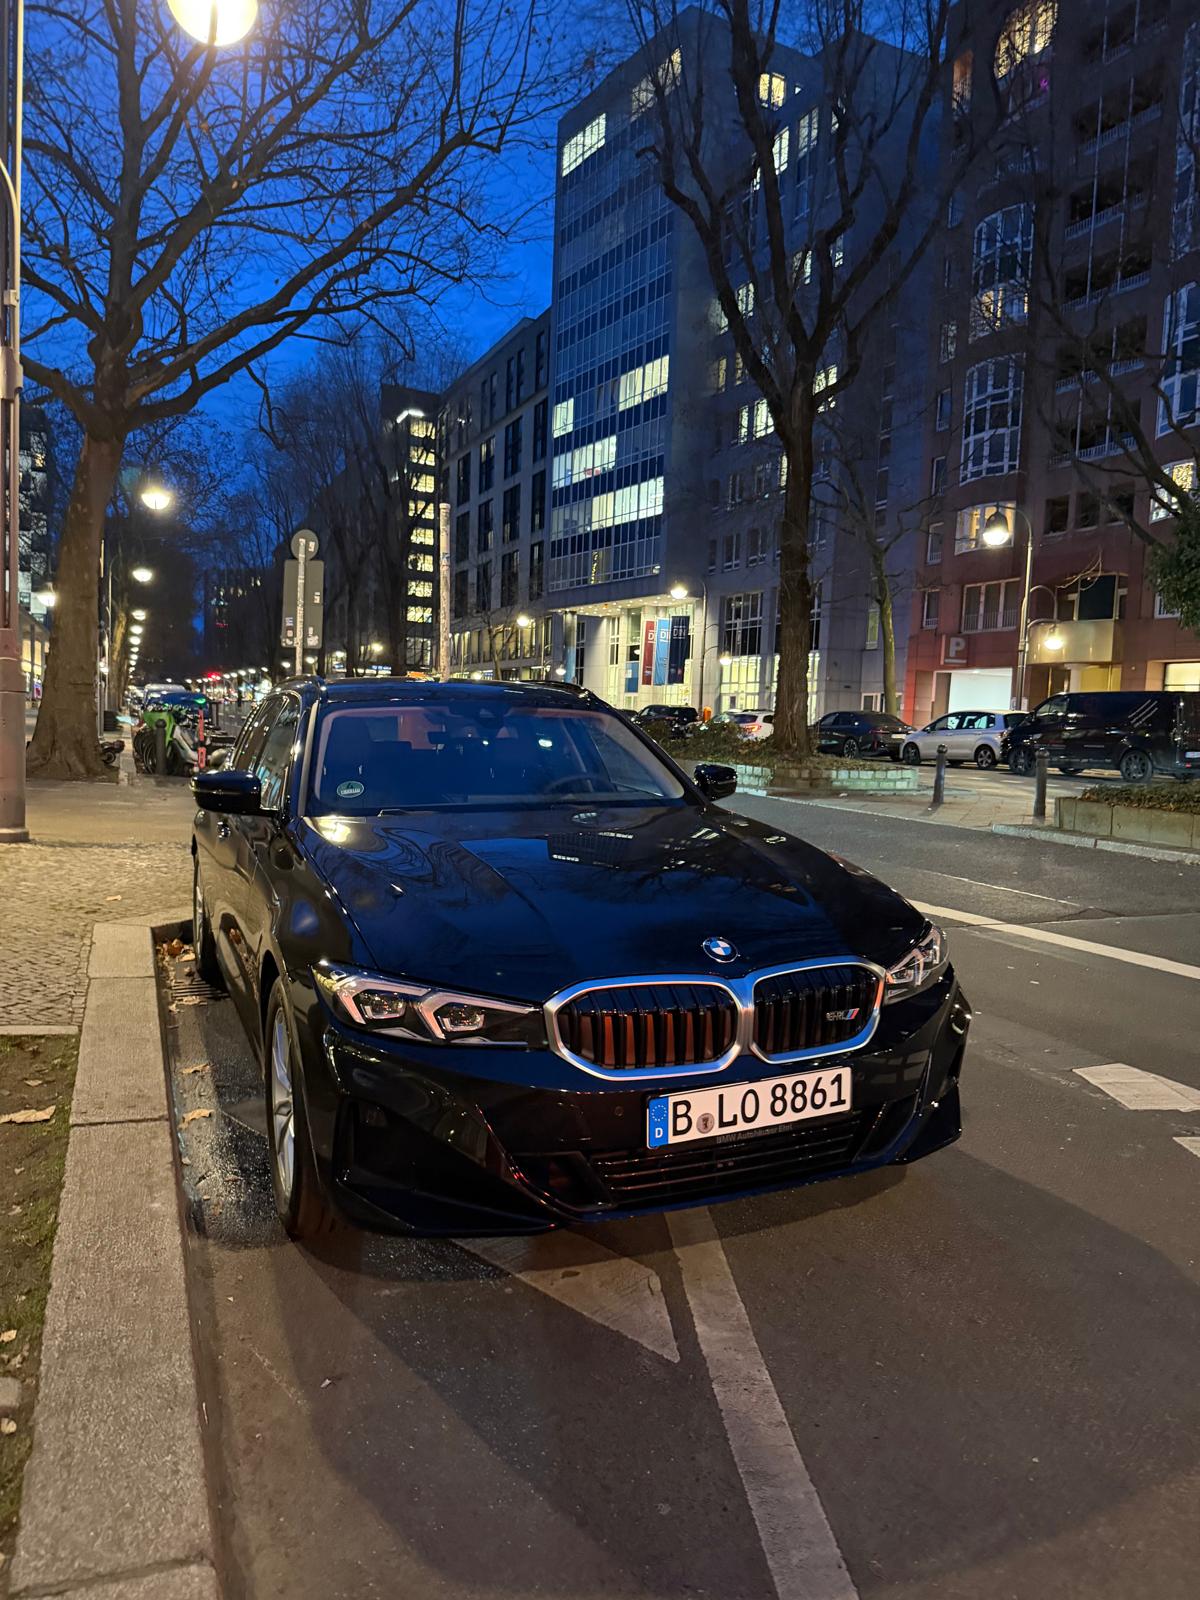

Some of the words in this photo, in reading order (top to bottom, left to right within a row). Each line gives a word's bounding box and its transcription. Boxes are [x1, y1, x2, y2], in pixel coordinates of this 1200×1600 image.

[949, 637, 966, 657] P
[672, 1099, 692, 1137] B
[718, 1089, 760, 1128] LO
[770, 1073, 847, 1117] 8861
[655, 1127, 664, 1139] D
[716, 1133, 736, 1145] BMW
